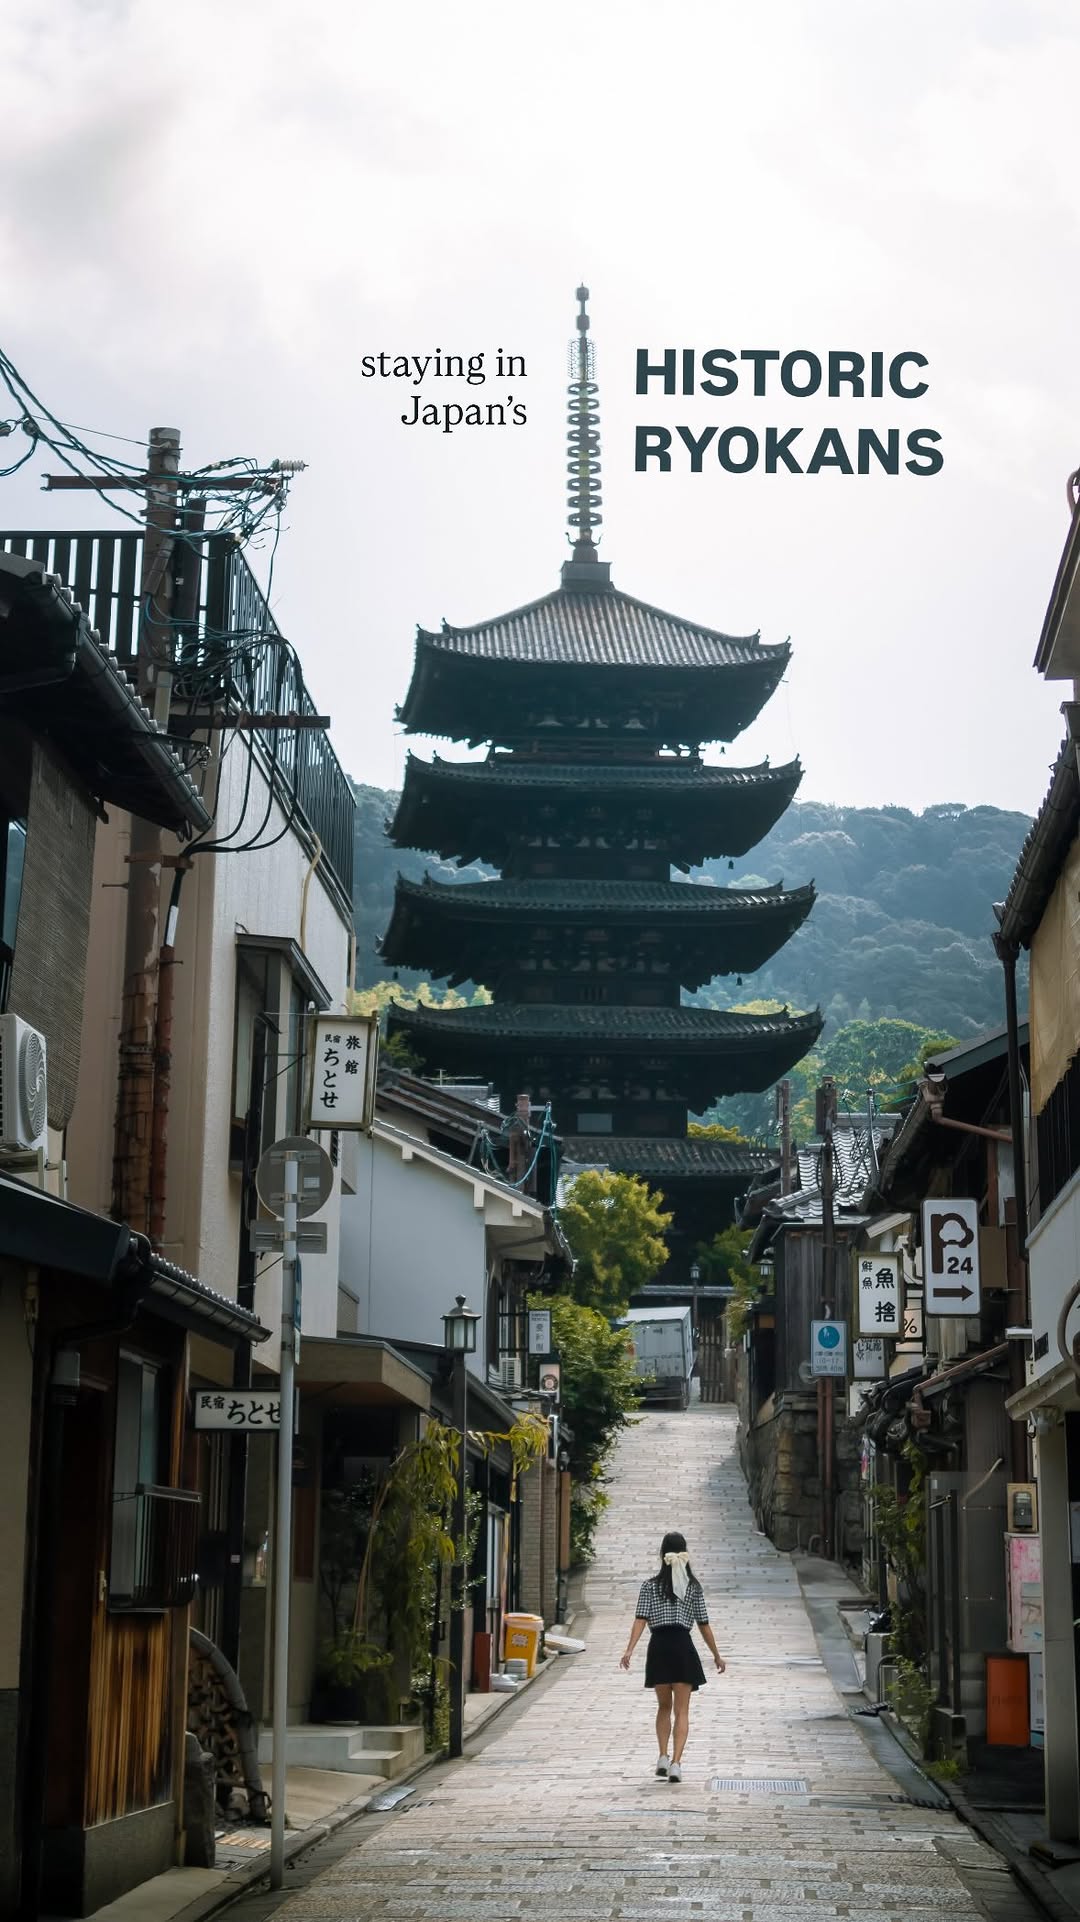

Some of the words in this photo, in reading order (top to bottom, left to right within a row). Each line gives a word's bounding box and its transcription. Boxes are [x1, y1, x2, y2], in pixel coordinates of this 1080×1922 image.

[324, 1034, 341, 1043] 民宿
[345, 1035, 362, 1075] 旅館
[320, 1048, 340, 1108] ちとせ
[861, 1260, 873, 1290] 鮮魚
[947, 1256, 974, 1275] 24
[200, 1395, 225, 1409] 民宿
[227, 1400, 280, 1425] ちとせ
